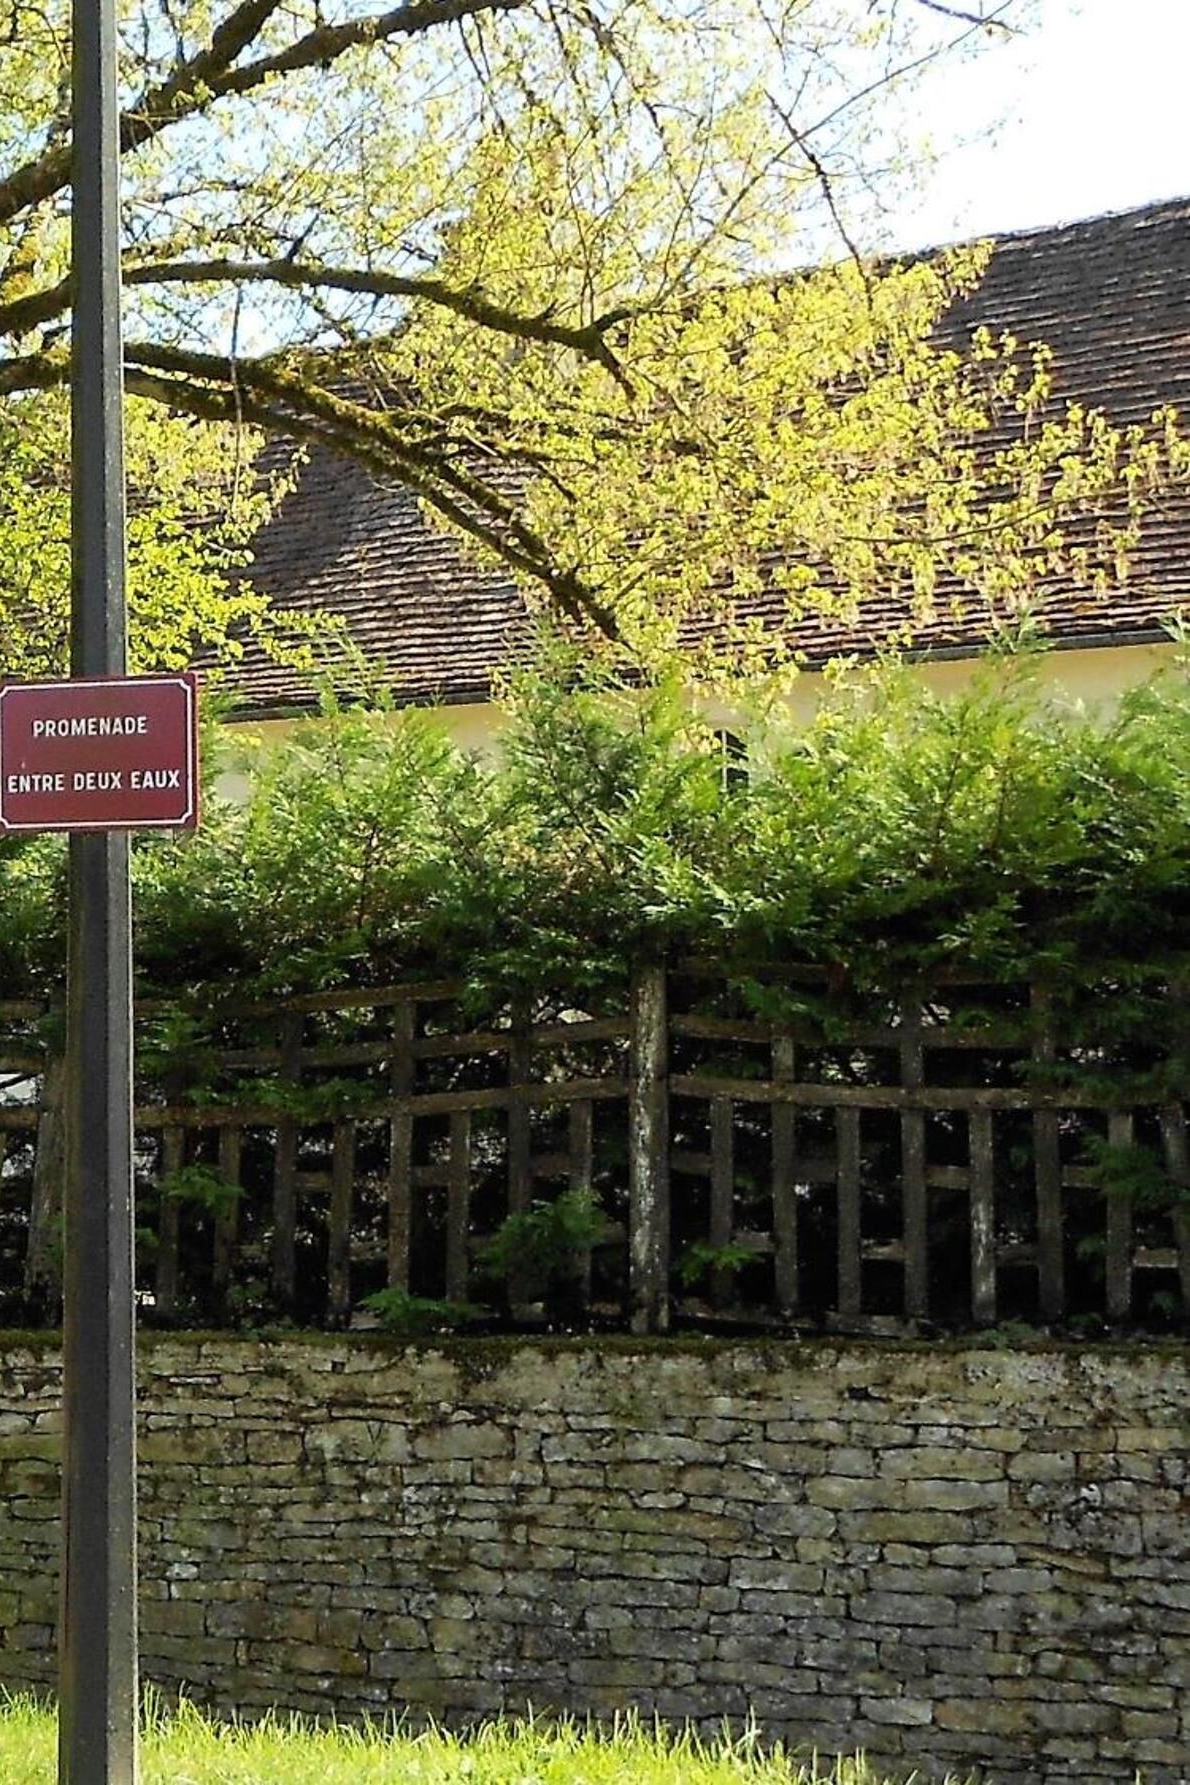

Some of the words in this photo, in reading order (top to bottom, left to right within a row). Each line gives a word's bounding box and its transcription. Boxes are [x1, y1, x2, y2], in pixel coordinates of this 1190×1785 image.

[32, 716, 148, 738] PROMENADE
[8, 773, 65, 794] ENTRE
[73, 771, 122, 791] DEUX
[130, 769, 180, 789] EAUX
